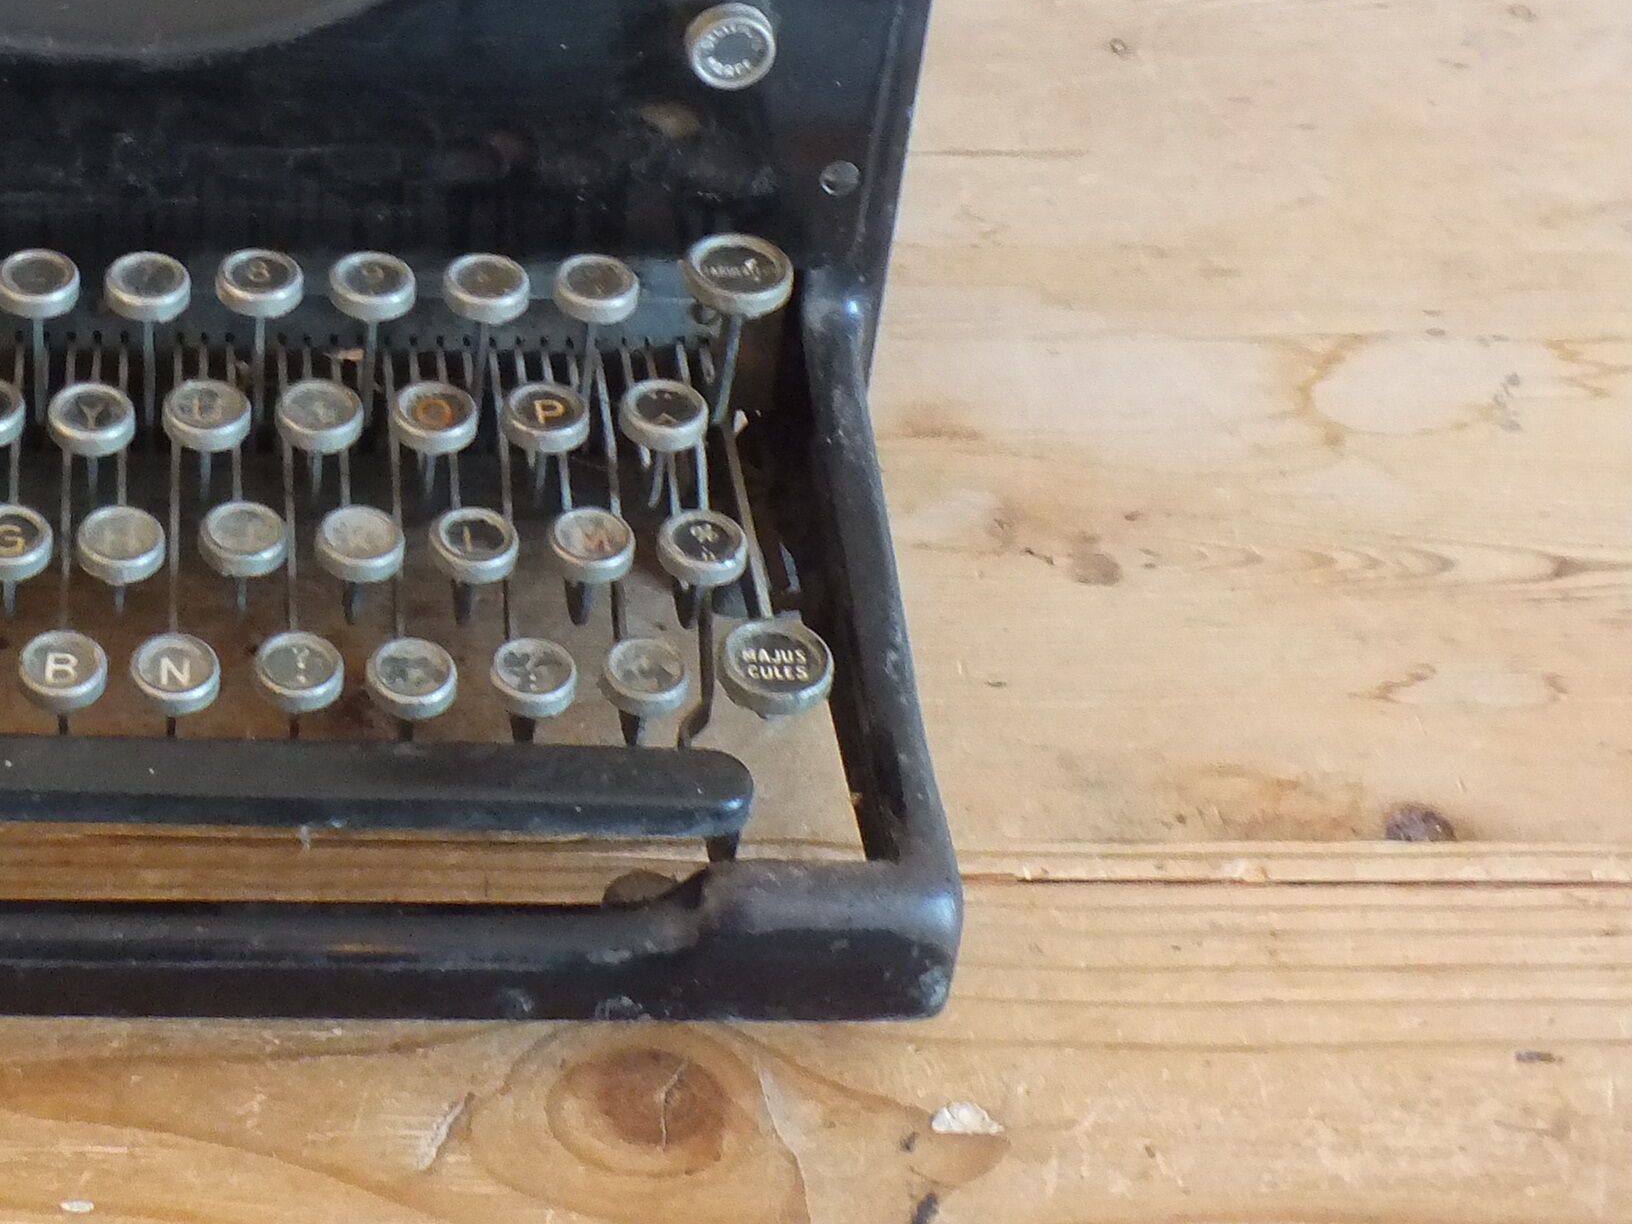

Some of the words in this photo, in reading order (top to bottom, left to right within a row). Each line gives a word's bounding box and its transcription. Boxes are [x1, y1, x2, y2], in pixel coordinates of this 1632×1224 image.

[247, 259, 271, 283] 8
[77, 400, 106, 429] Y
[414, 397, 453, 428] O
[532, 398, 566, 426] P
[43, 652, 79, 685] B
[741, 647, 808, 665] MAJUS
[159, 655, 191, 687] N
[747, 663, 809, 682] CULES
